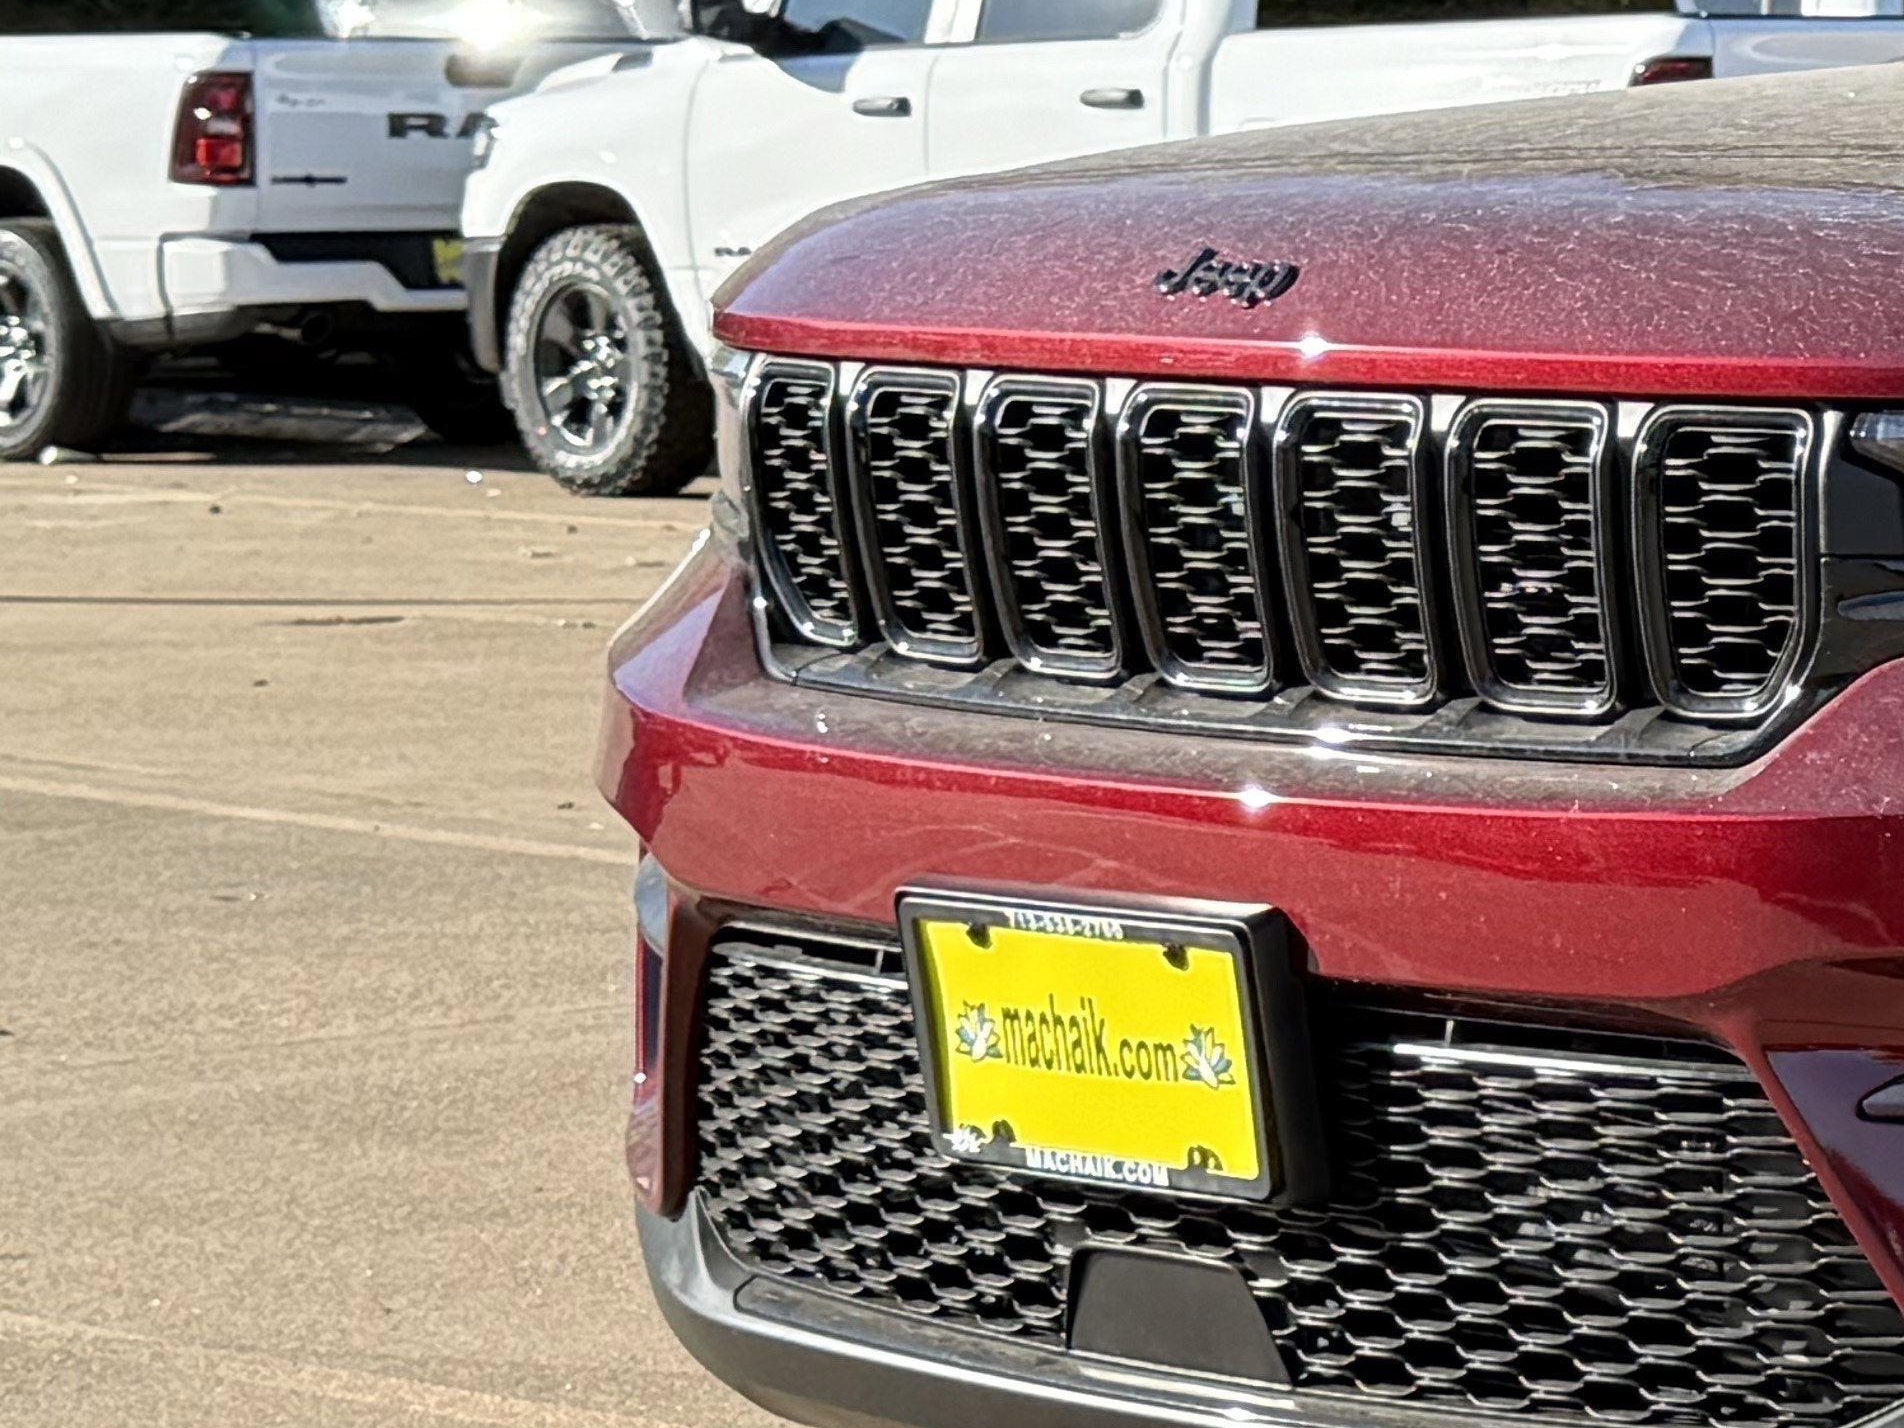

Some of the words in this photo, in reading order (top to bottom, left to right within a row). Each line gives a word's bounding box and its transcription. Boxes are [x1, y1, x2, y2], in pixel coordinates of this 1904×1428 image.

[387, 112, 492, 140] RA
[1153, 247, 1300, 310] Jeep
[1000, 993, 1179, 1082] machaik.com
[1025, 1146, 1170, 1187] MACHAIK.COM
